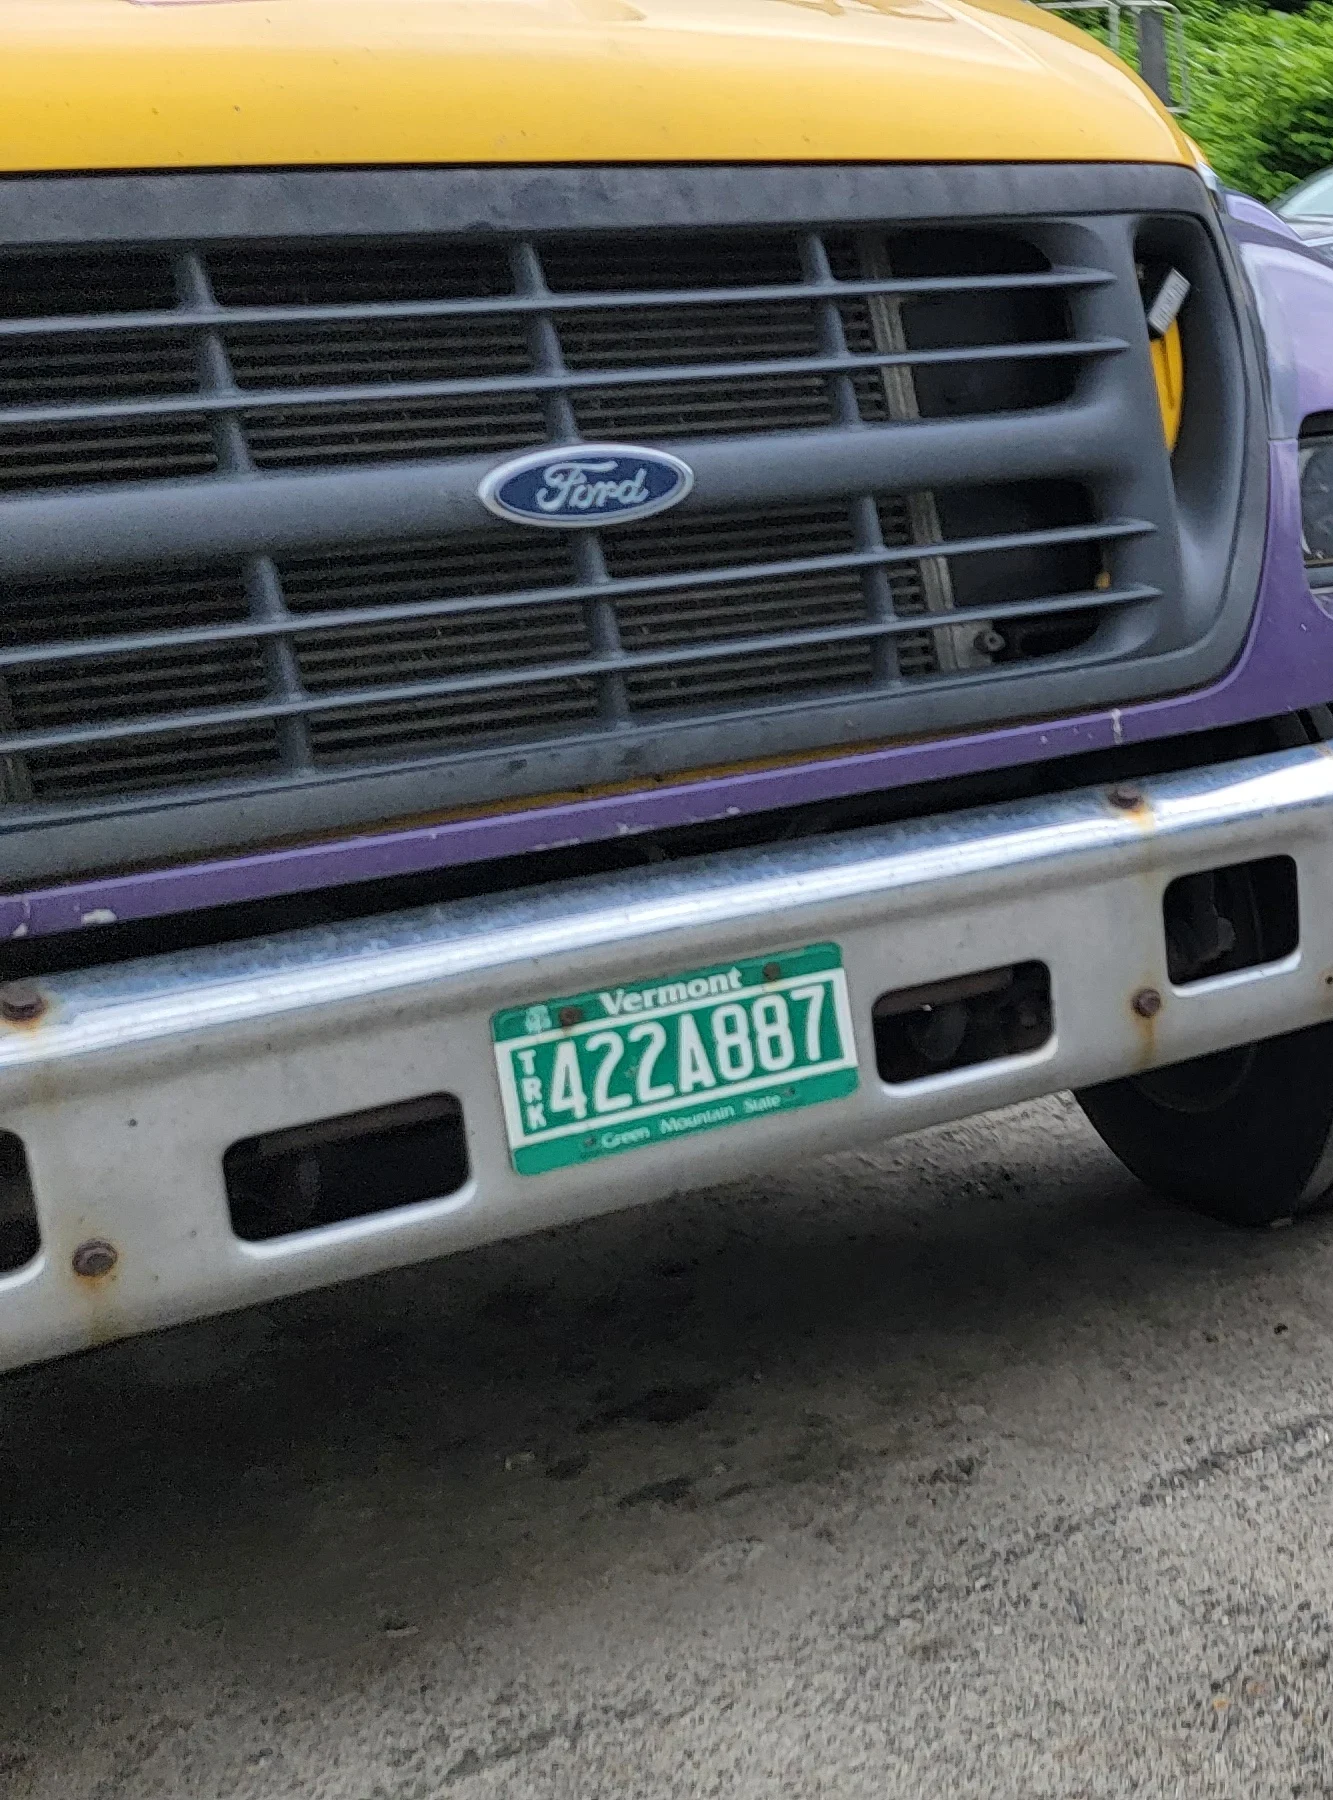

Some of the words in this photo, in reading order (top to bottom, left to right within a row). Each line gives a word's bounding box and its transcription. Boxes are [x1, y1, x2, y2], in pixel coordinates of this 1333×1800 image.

[536, 461, 649, 511] Ford
[600, 966, 743, 1016] Vermont
[549, 984, 825, 1120] 422A887
[601, 1127, 651, 1149] Green
[660, 1105, 736, 1134] Mountain
[743, 1094, 782, 1114] State
